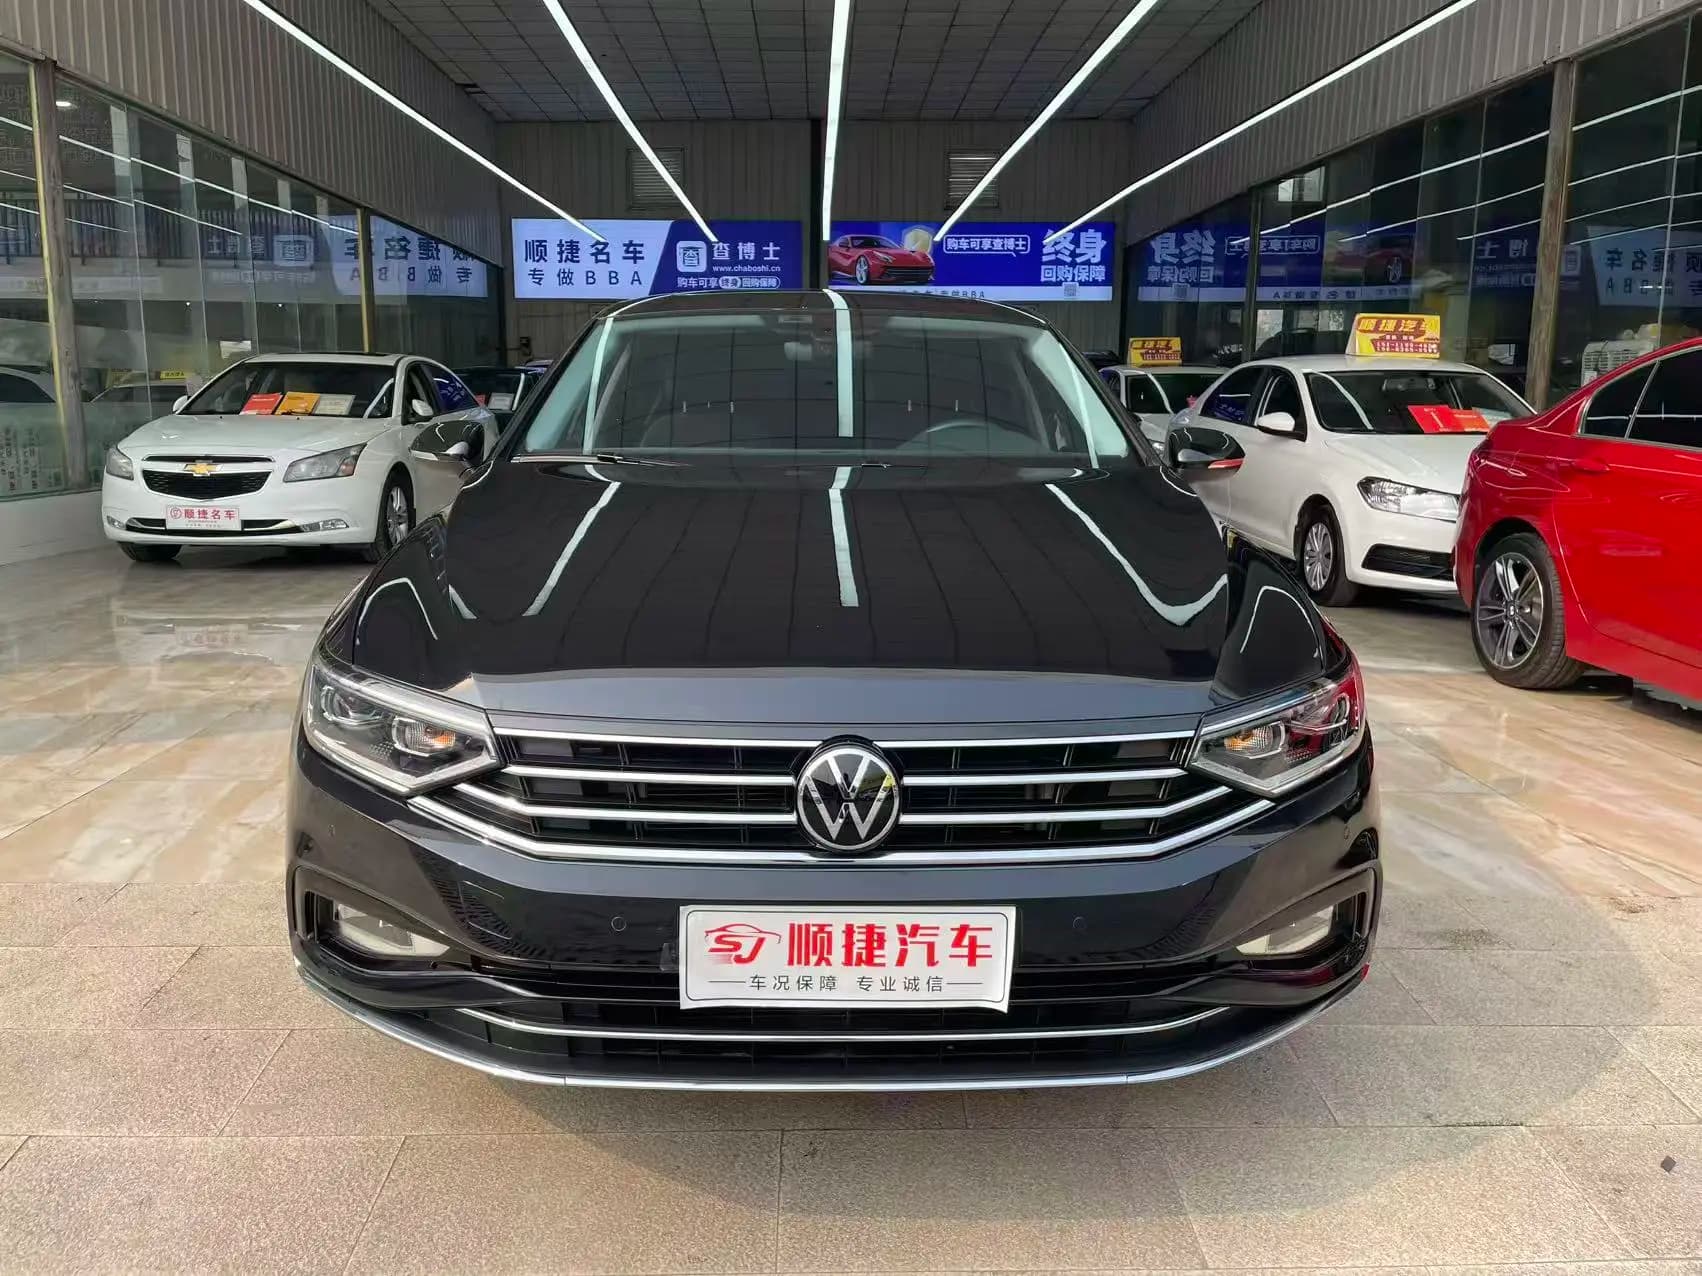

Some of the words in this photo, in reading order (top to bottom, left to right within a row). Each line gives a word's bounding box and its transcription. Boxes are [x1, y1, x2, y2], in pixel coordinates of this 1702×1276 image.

[524, 239, 645, 264] 顺捷名车
[711, 242, 781, 261] 查博士
[946, 238, 1027, 250] 购车可享查博士
[1042, 229, 1107, 263] 终身
[712, 260, 781, 272] www.chaboshi.cn
[1041, 265, 1106, 282] 回购保障
[528, 268, 642, 286] 专做BBA
[787, 923, 993, 968] 顺捷汽车
[749, 974, 838, 993] 车况保障
[856, 976, 943, 993] 专业诚信
